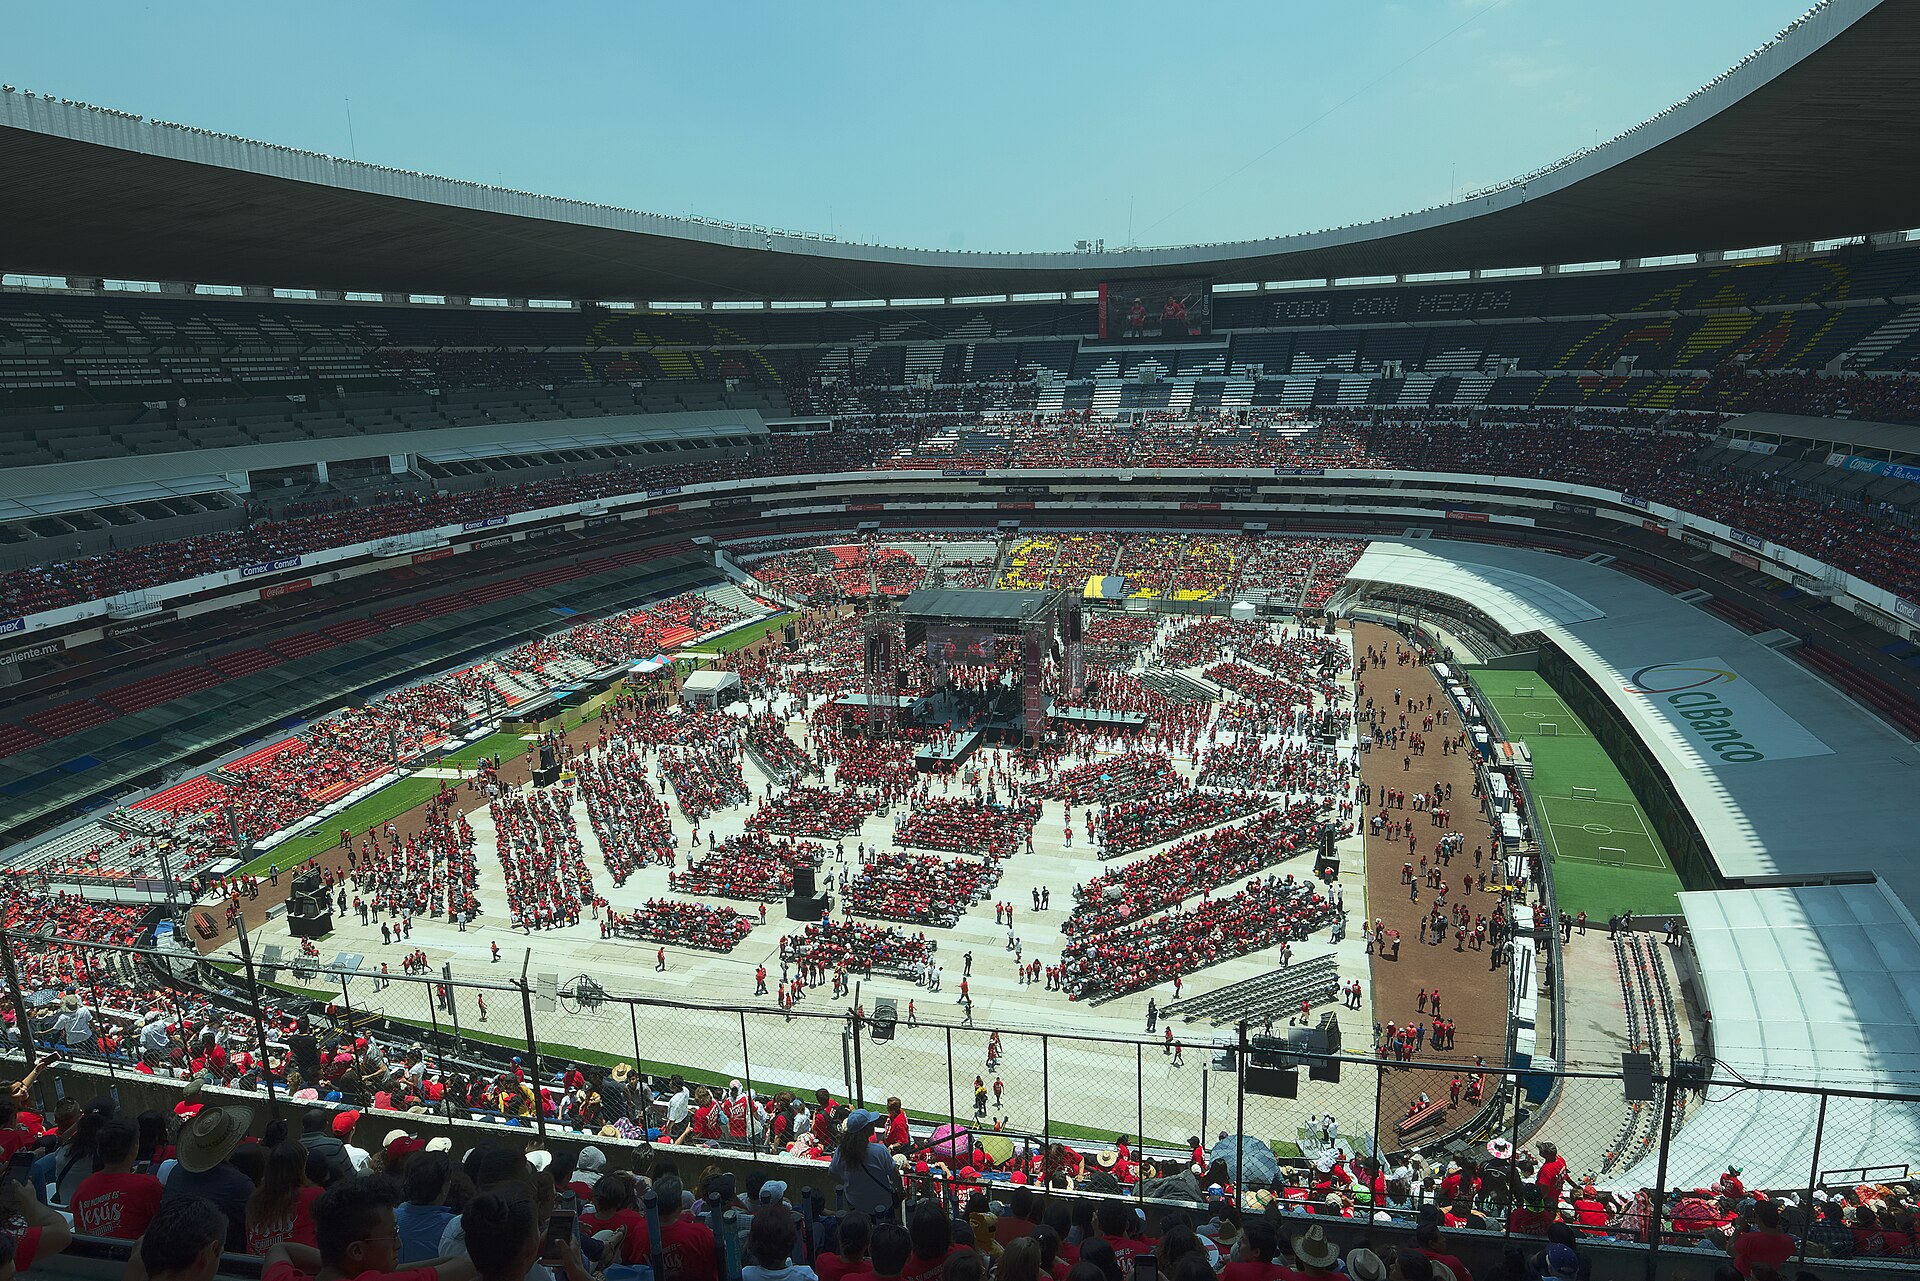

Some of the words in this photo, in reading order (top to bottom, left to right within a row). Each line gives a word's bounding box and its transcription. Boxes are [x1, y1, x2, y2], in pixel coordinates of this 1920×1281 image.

[1273, 300, 1330, 318] TODO
[1352, 296, 1399, 316] CON
[1417, 290, 1512, 312] MEDIDA
[1850, 458, 1880, 472] Comex
[465, 521, 484, 530] Comex
[487, 517, 505, 526] Comex
[243, 564, 268, 576] Comex
[274, 558, 298, 570] Comex
[1896, 601, 1916, 618] Comex
[0, 644, 58, 666] caliente.mx
[1668, 691, 1765, 762] CIBanco
[112, 1190, 120, 1199] ES
